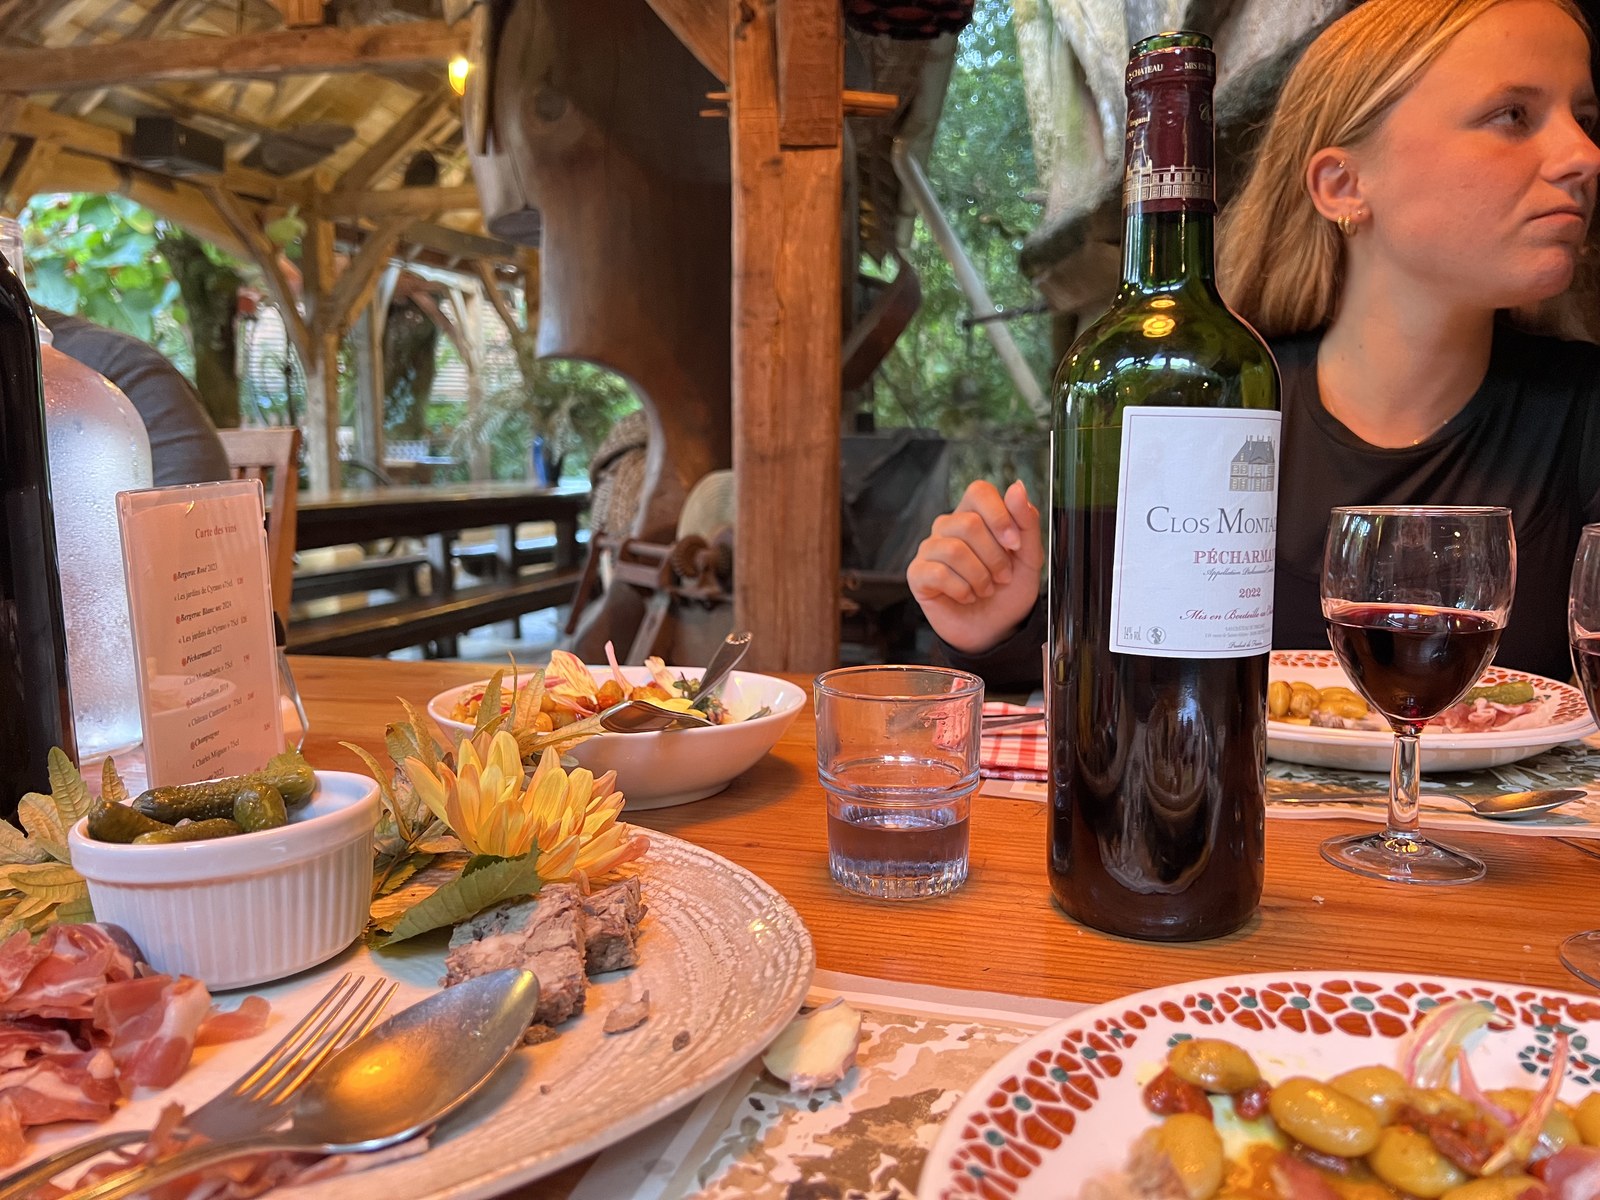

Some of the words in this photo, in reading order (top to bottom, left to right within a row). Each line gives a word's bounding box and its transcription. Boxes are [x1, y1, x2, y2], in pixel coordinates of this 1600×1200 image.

[195, 528, 212, 539] Carte
[214, 525, 224, 535] des
[225, 524, 237, 533] vins
[1238, 587, 1262, 599] 2022
[180, 611, 201, 622] Bergerac
[1179, 608, 1207, 621] Mis
[1209, 613, 1222, 621] en
